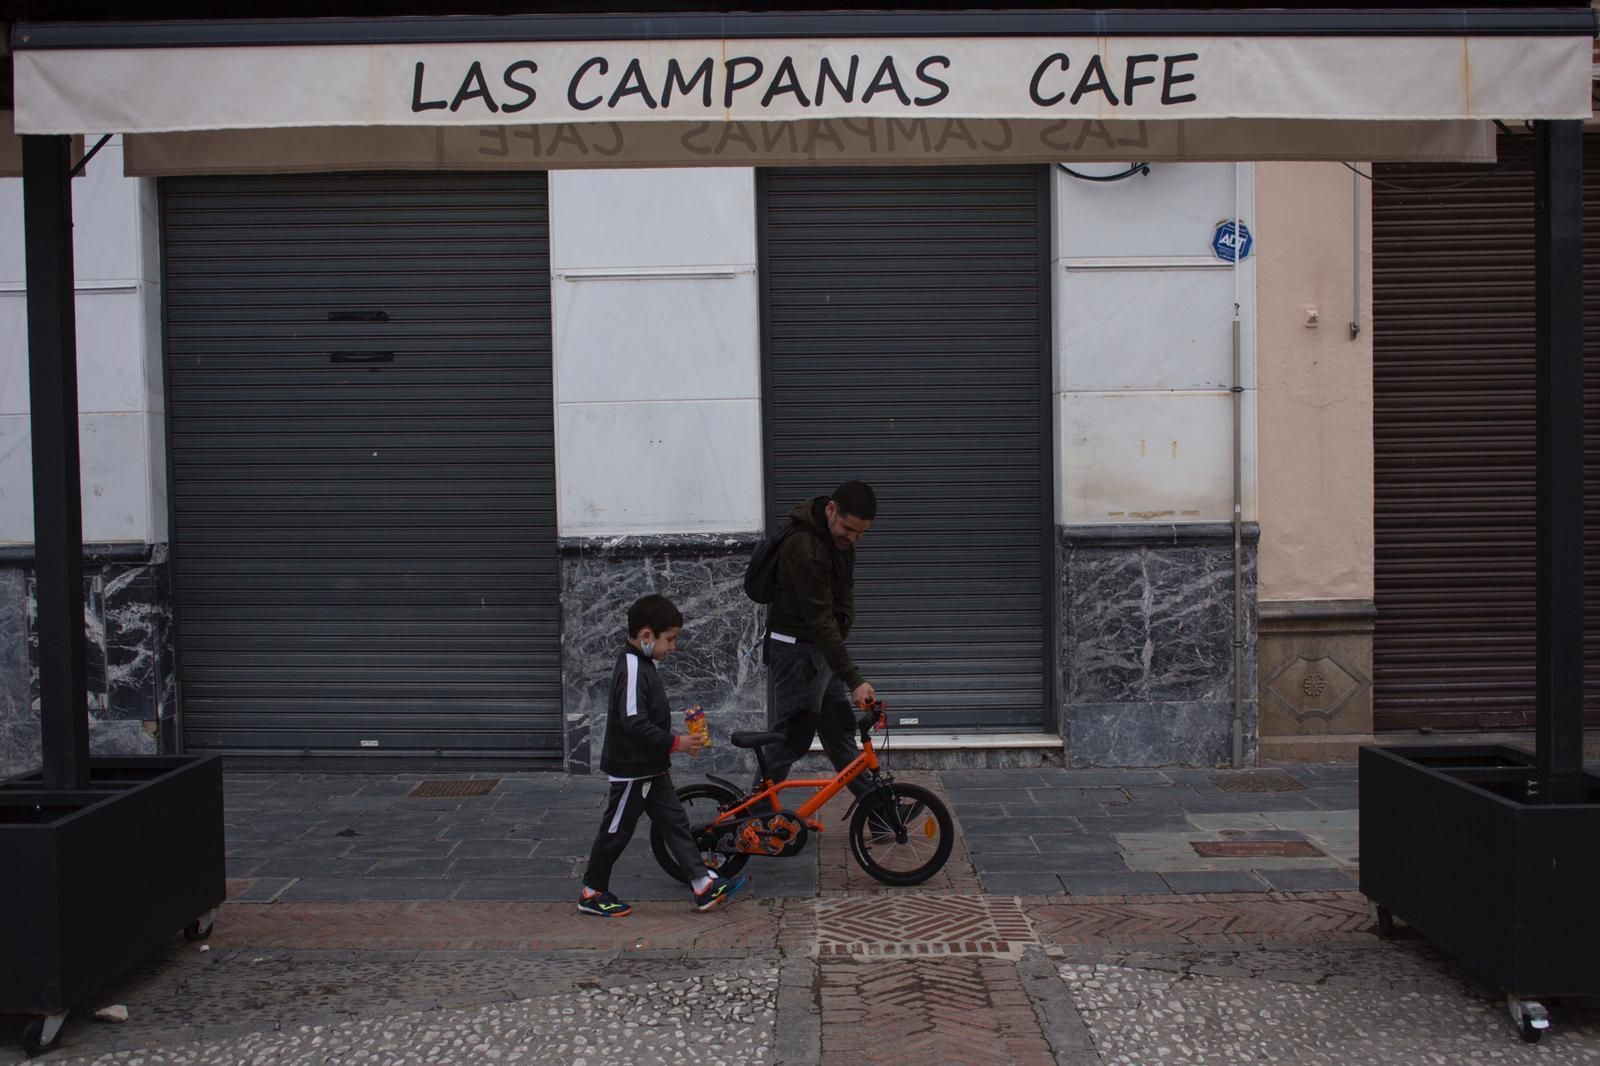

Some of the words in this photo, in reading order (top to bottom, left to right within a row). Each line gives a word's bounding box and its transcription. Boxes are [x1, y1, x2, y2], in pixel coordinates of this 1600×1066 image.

[411, 59, 538, 114] LAS
[567, 54, 951, 111] CAMPANAS
[1029, 52, 1199, 107] CAFE
[1219, 233, 1247, 250] ADT
